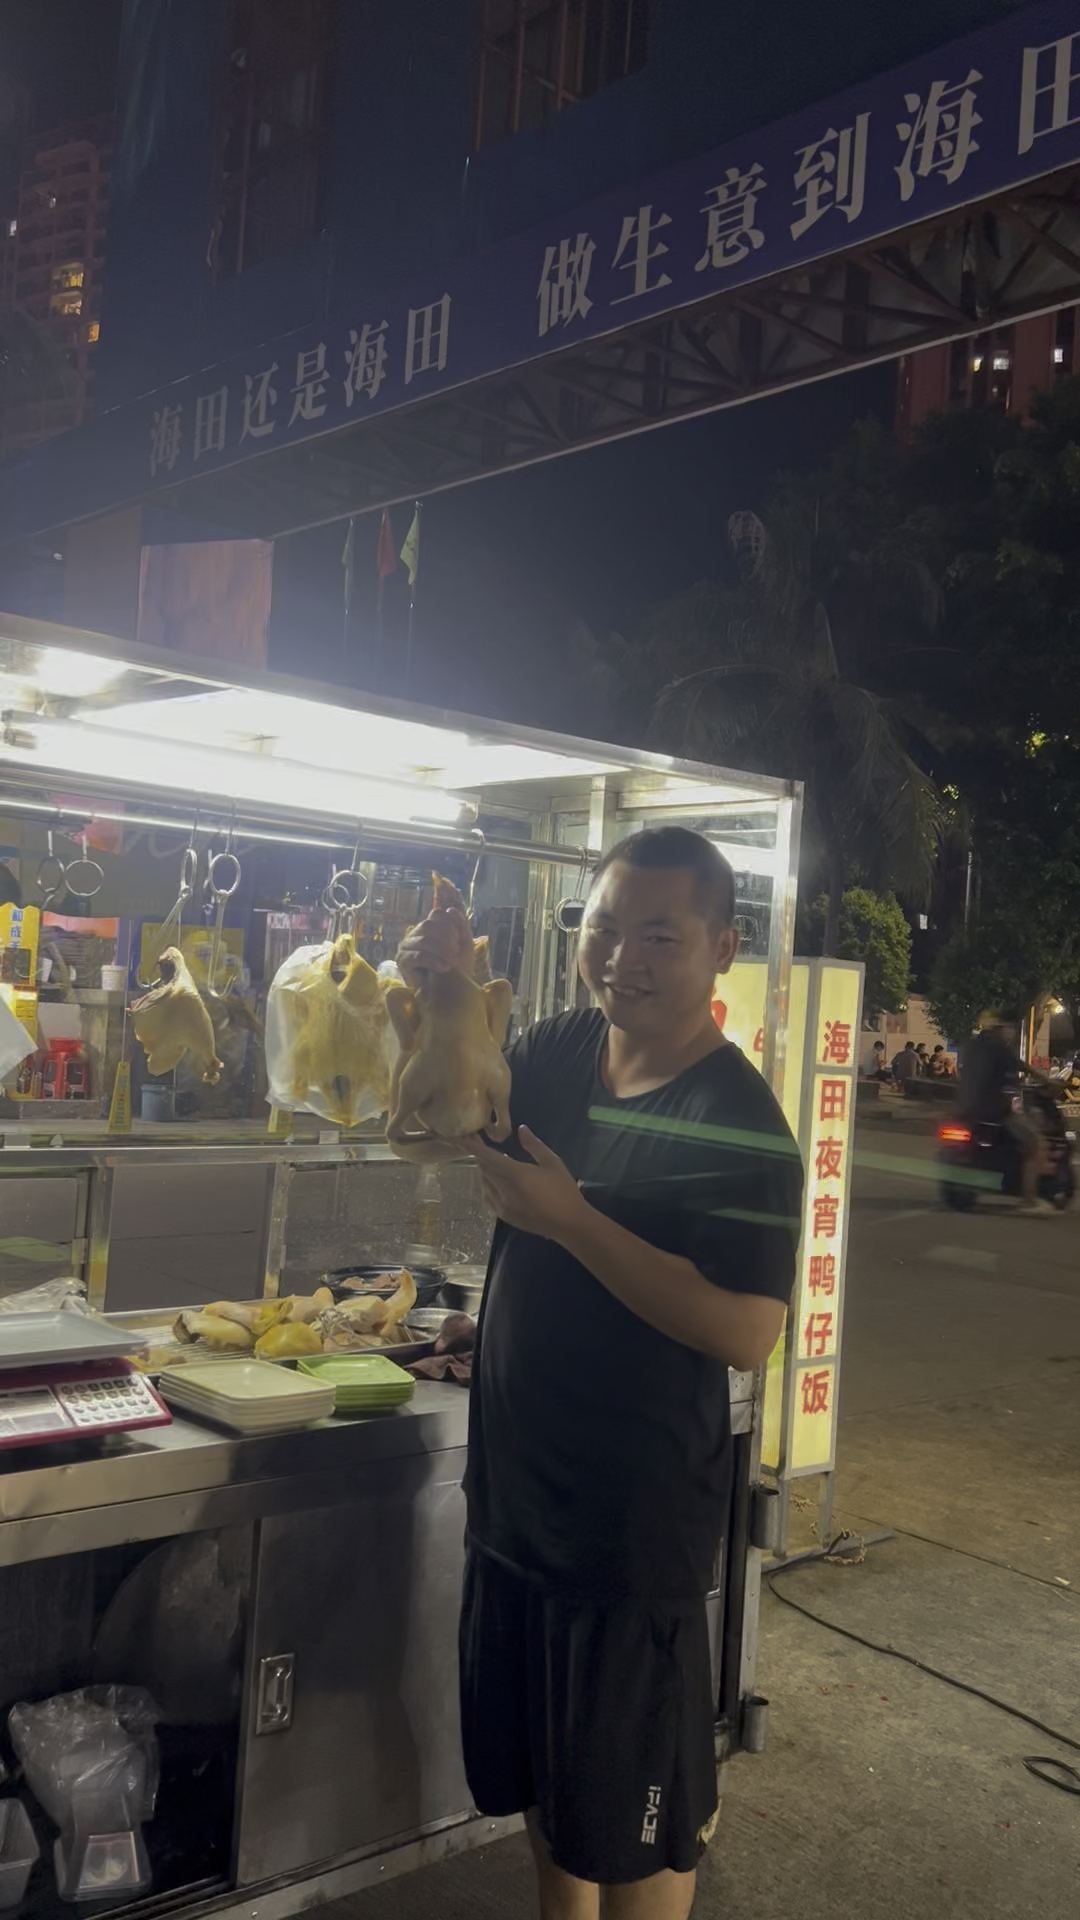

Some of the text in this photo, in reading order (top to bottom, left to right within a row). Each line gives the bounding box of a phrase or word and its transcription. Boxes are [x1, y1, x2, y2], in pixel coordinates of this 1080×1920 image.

[148, 31, 1080, 477] 海田还是海田 做生意到海田
[801, 1020, 852, 1416] 海田夜宵鸭仔饭
